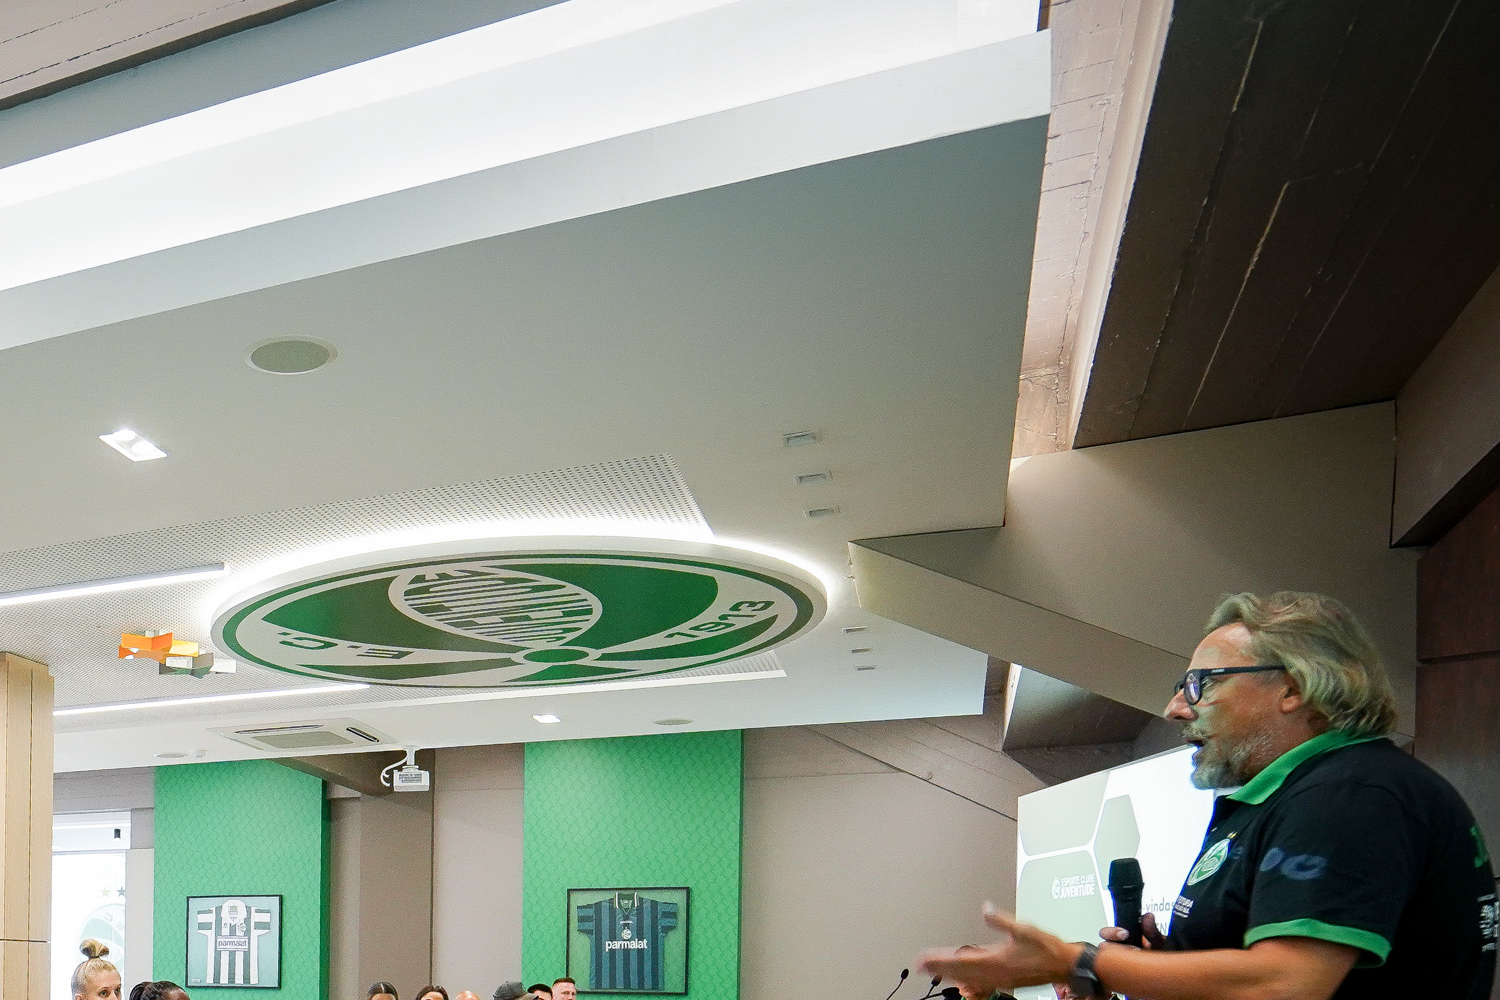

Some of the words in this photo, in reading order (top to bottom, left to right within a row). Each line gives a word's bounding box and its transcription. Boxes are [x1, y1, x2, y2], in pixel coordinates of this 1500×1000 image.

[664, 600, 775, 639] 1913
[1060, 883, 1095, 899] JUVENTUDE
[217, 939, 247, 948] parmalat
[605, 938, 648, 952] parmalat
